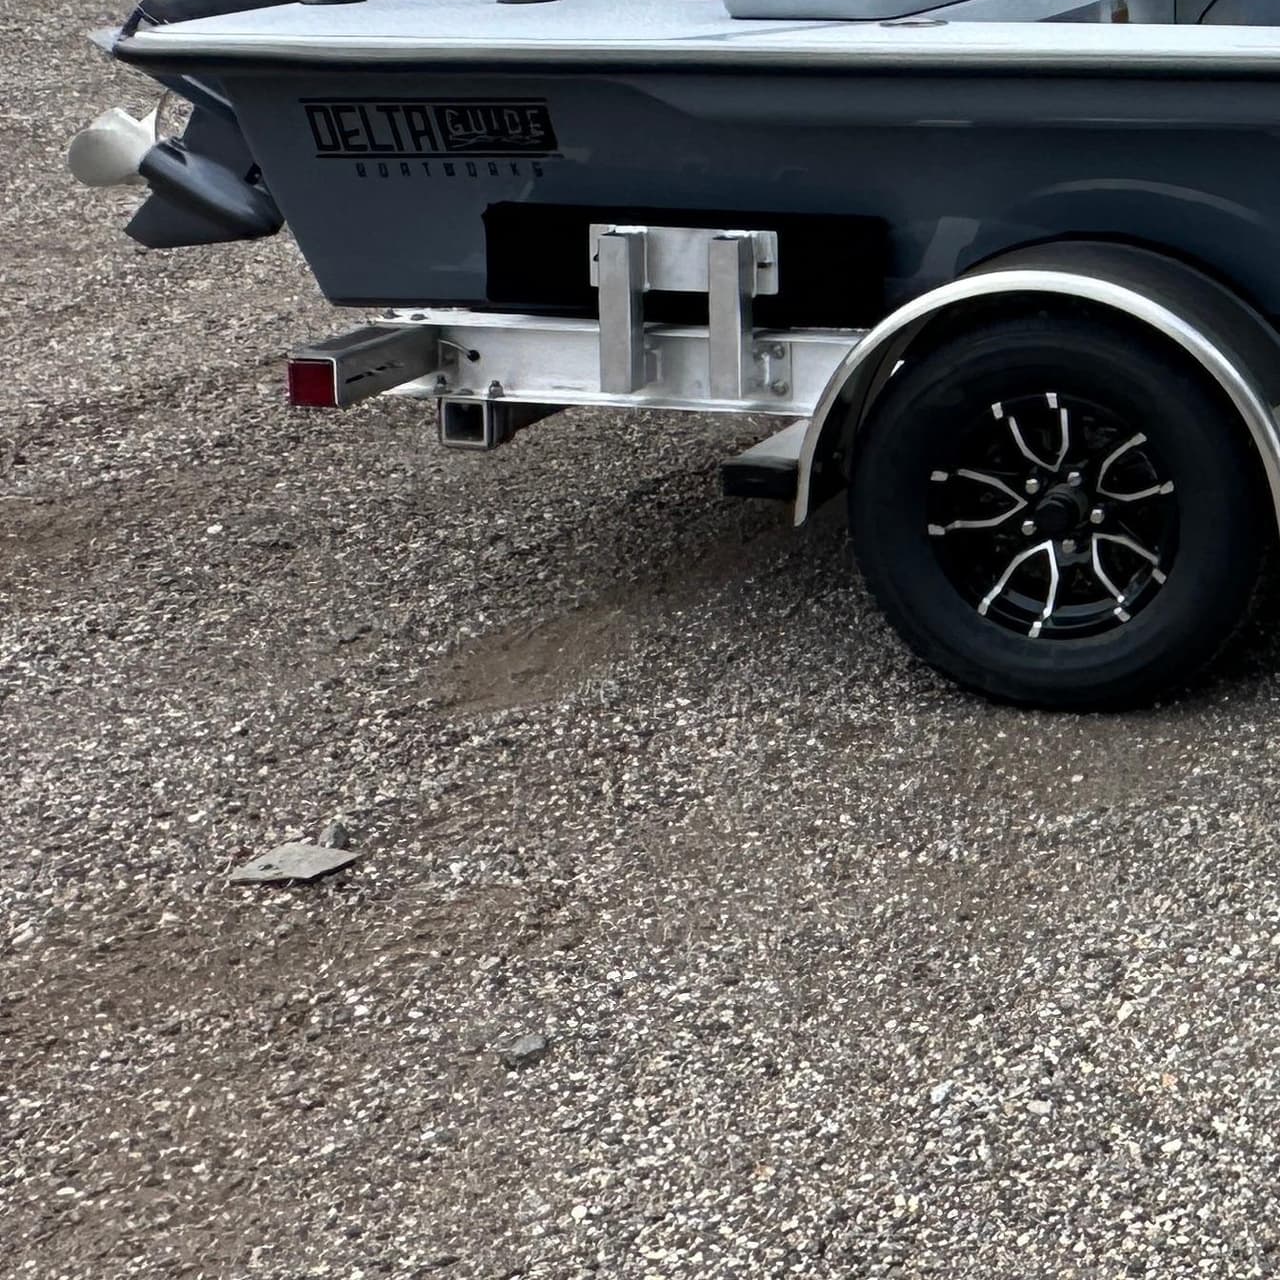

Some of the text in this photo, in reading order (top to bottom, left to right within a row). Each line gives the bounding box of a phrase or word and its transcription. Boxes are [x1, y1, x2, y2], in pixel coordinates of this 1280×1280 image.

[304, 104, 546, 152] DELTA GUIDE
[355, 161, 544, 178] BOATWORKS
